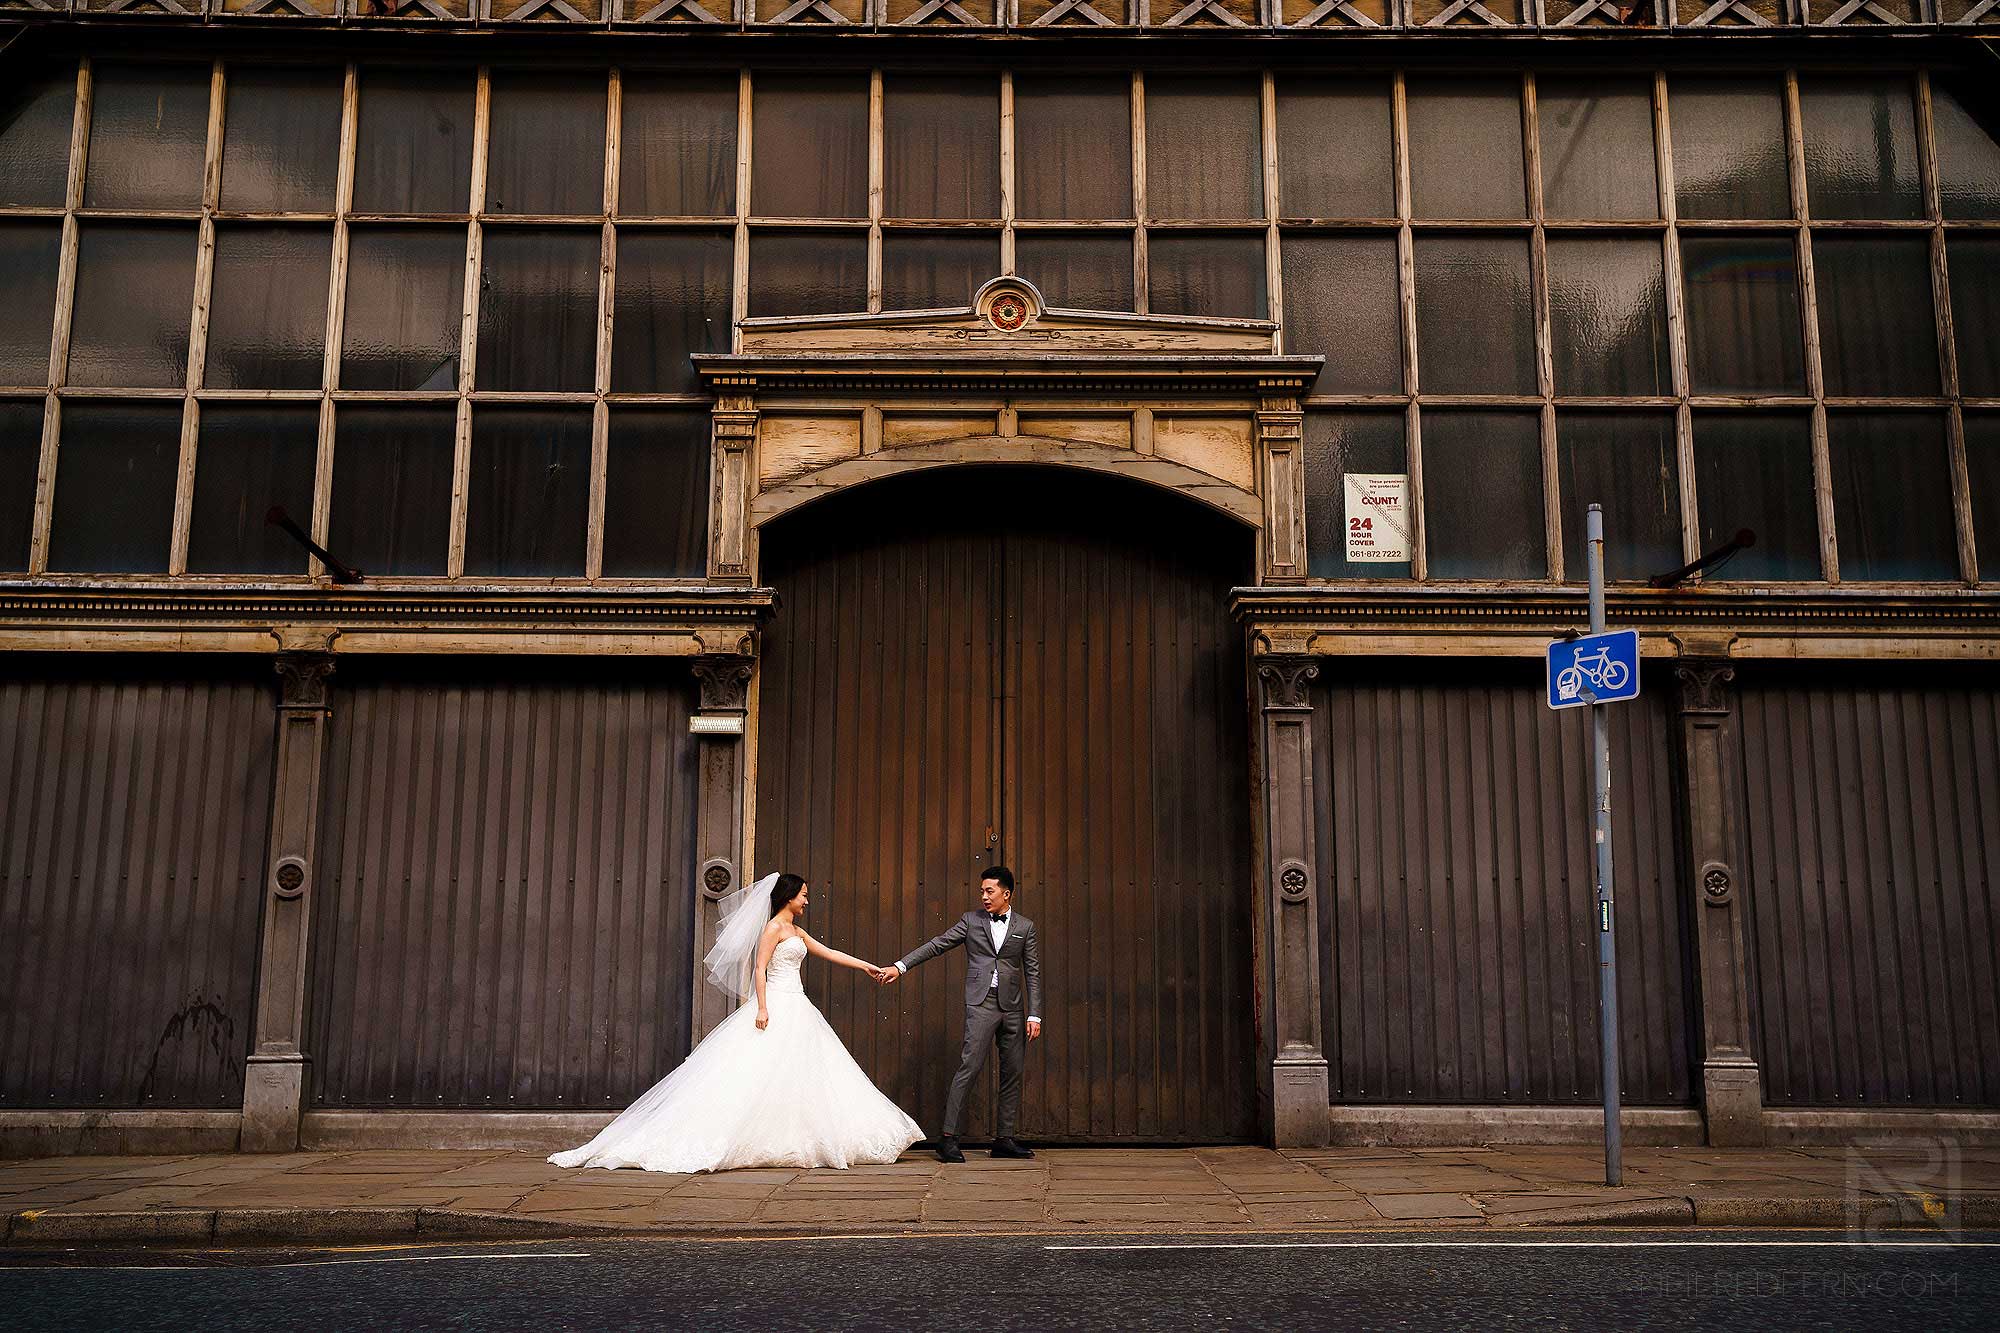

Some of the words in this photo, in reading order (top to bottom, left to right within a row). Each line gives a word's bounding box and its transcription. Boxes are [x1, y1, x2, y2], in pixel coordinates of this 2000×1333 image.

[1361, 496, 1399, 505] COUNTY
[1349, 517, 1373, 531] 24
[1382, 550, 1401, 558] 7222
